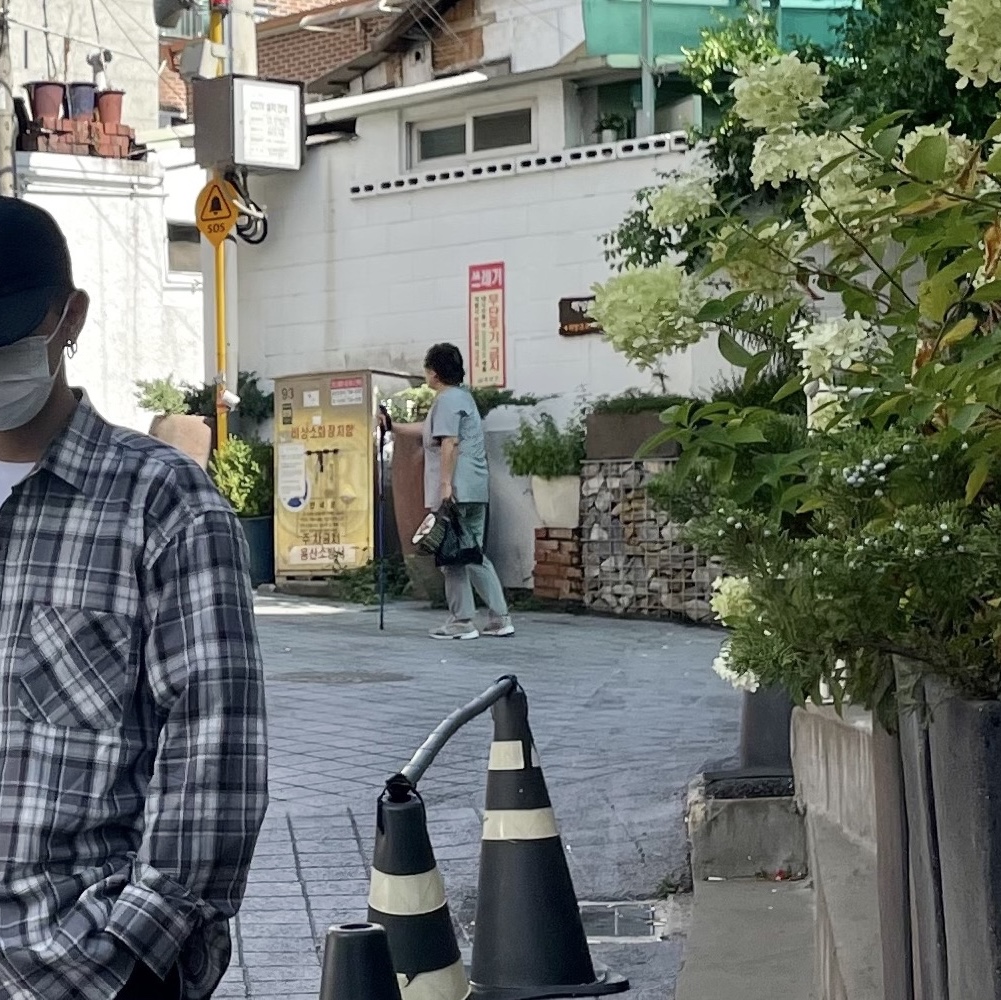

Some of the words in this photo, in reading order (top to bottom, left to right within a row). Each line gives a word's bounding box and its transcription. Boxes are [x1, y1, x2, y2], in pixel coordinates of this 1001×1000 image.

[207, 222, 225, 233] SOS
[471, 269, 501, 288] 쓰레기
[282, 387, 294, 400] 93
